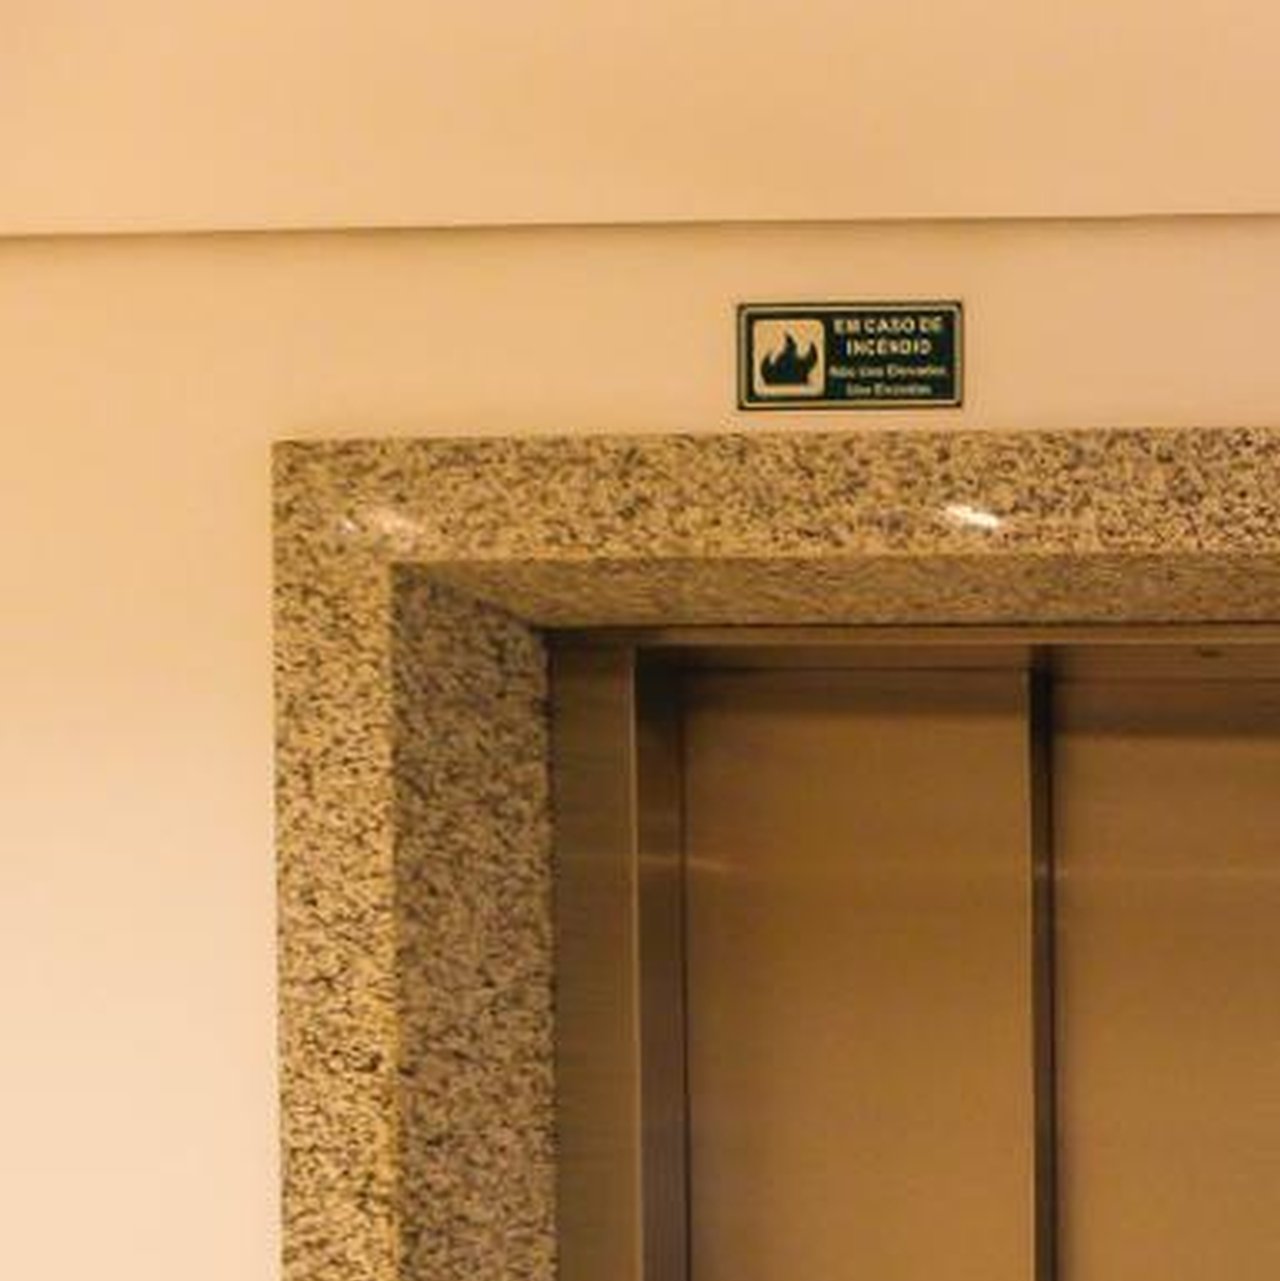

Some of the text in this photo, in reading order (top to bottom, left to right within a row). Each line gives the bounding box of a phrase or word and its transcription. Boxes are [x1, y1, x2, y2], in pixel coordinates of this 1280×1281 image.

[832, 315, 944, 334] EM CASO DE
